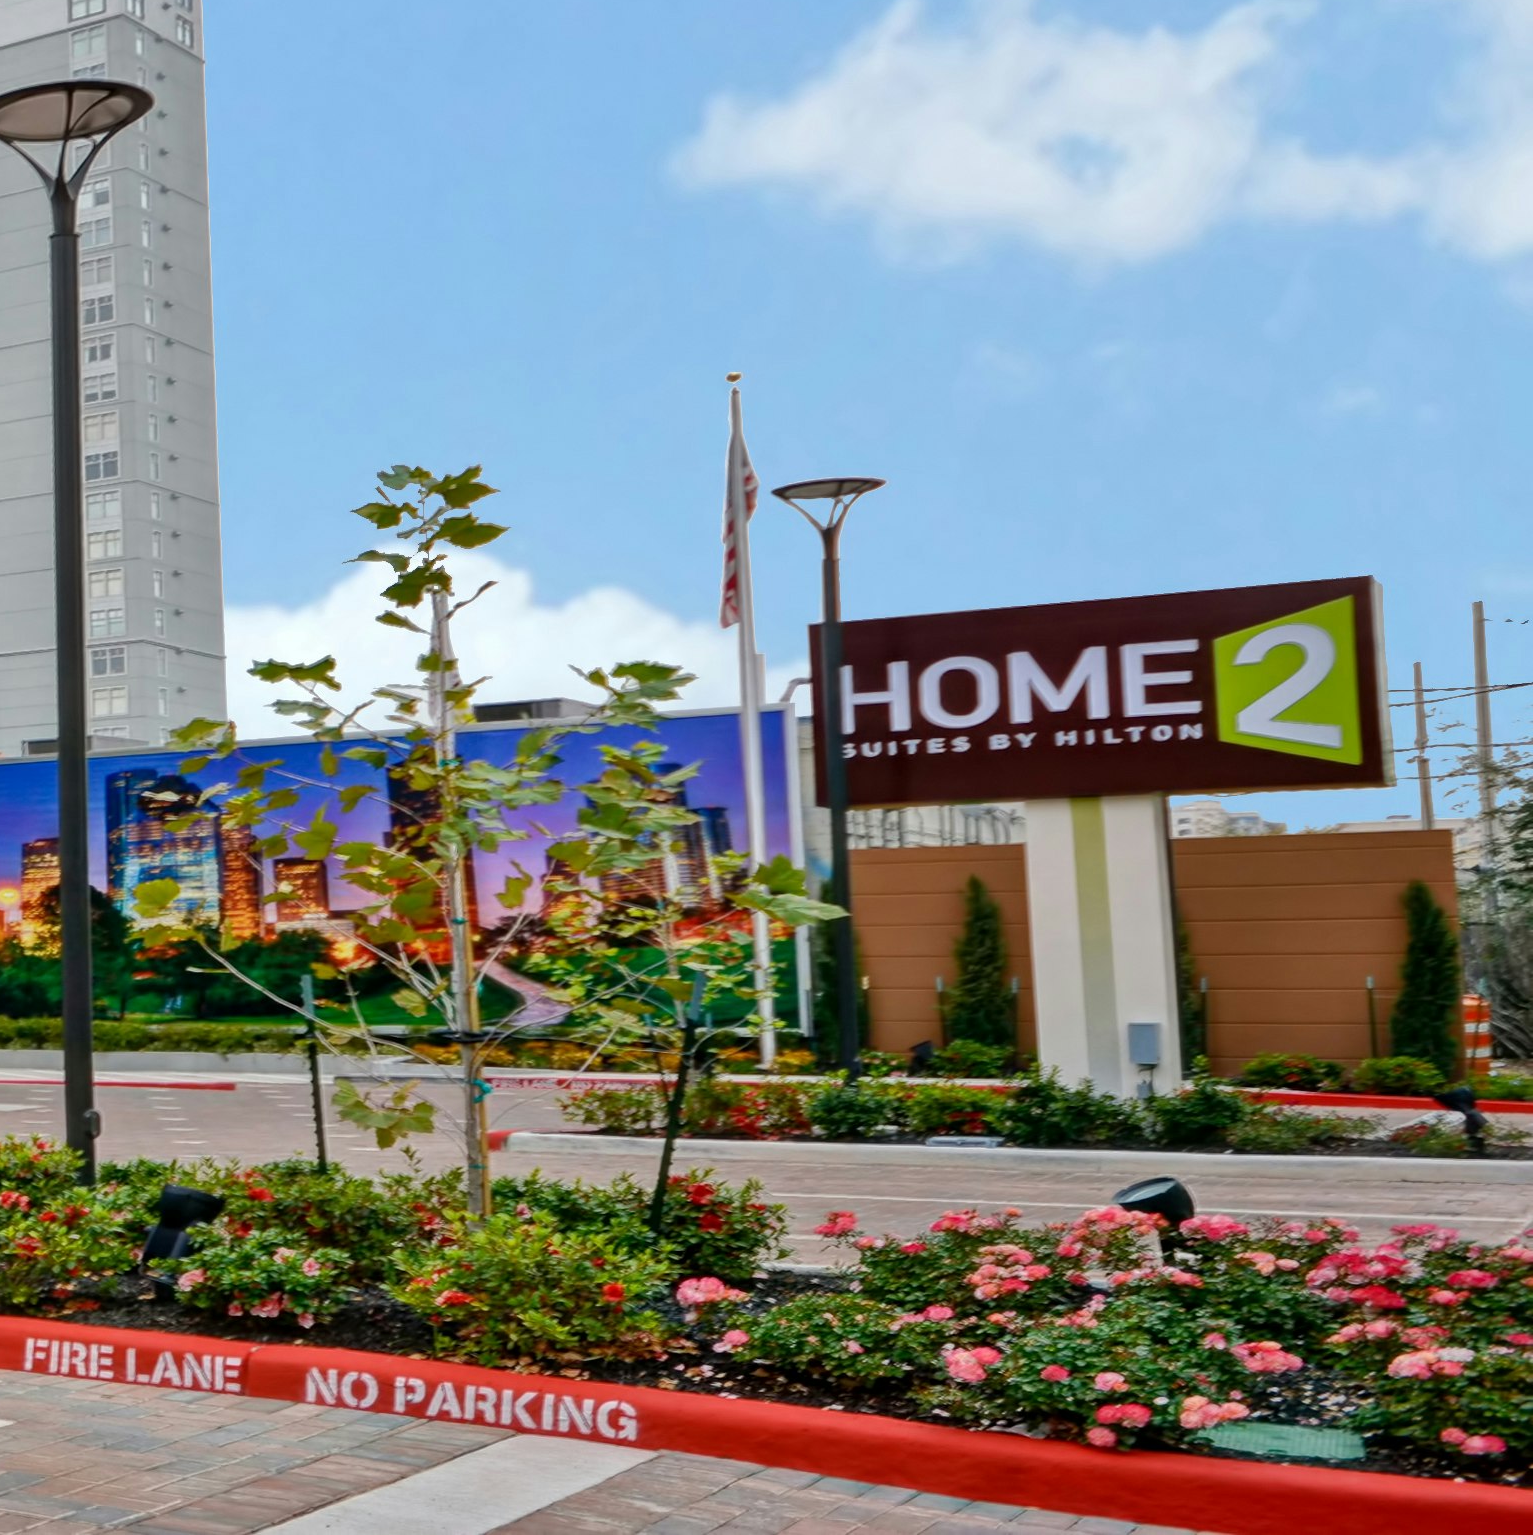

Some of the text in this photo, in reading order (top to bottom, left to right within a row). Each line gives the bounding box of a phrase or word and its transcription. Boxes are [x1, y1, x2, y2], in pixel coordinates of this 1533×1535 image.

[842, 622, 1343, 749] HOME 2
[842, 723, 1204, 758] SUITES BY HILTON
[24, 1337, 638, 1442] FIRE LANE NO PARKING
